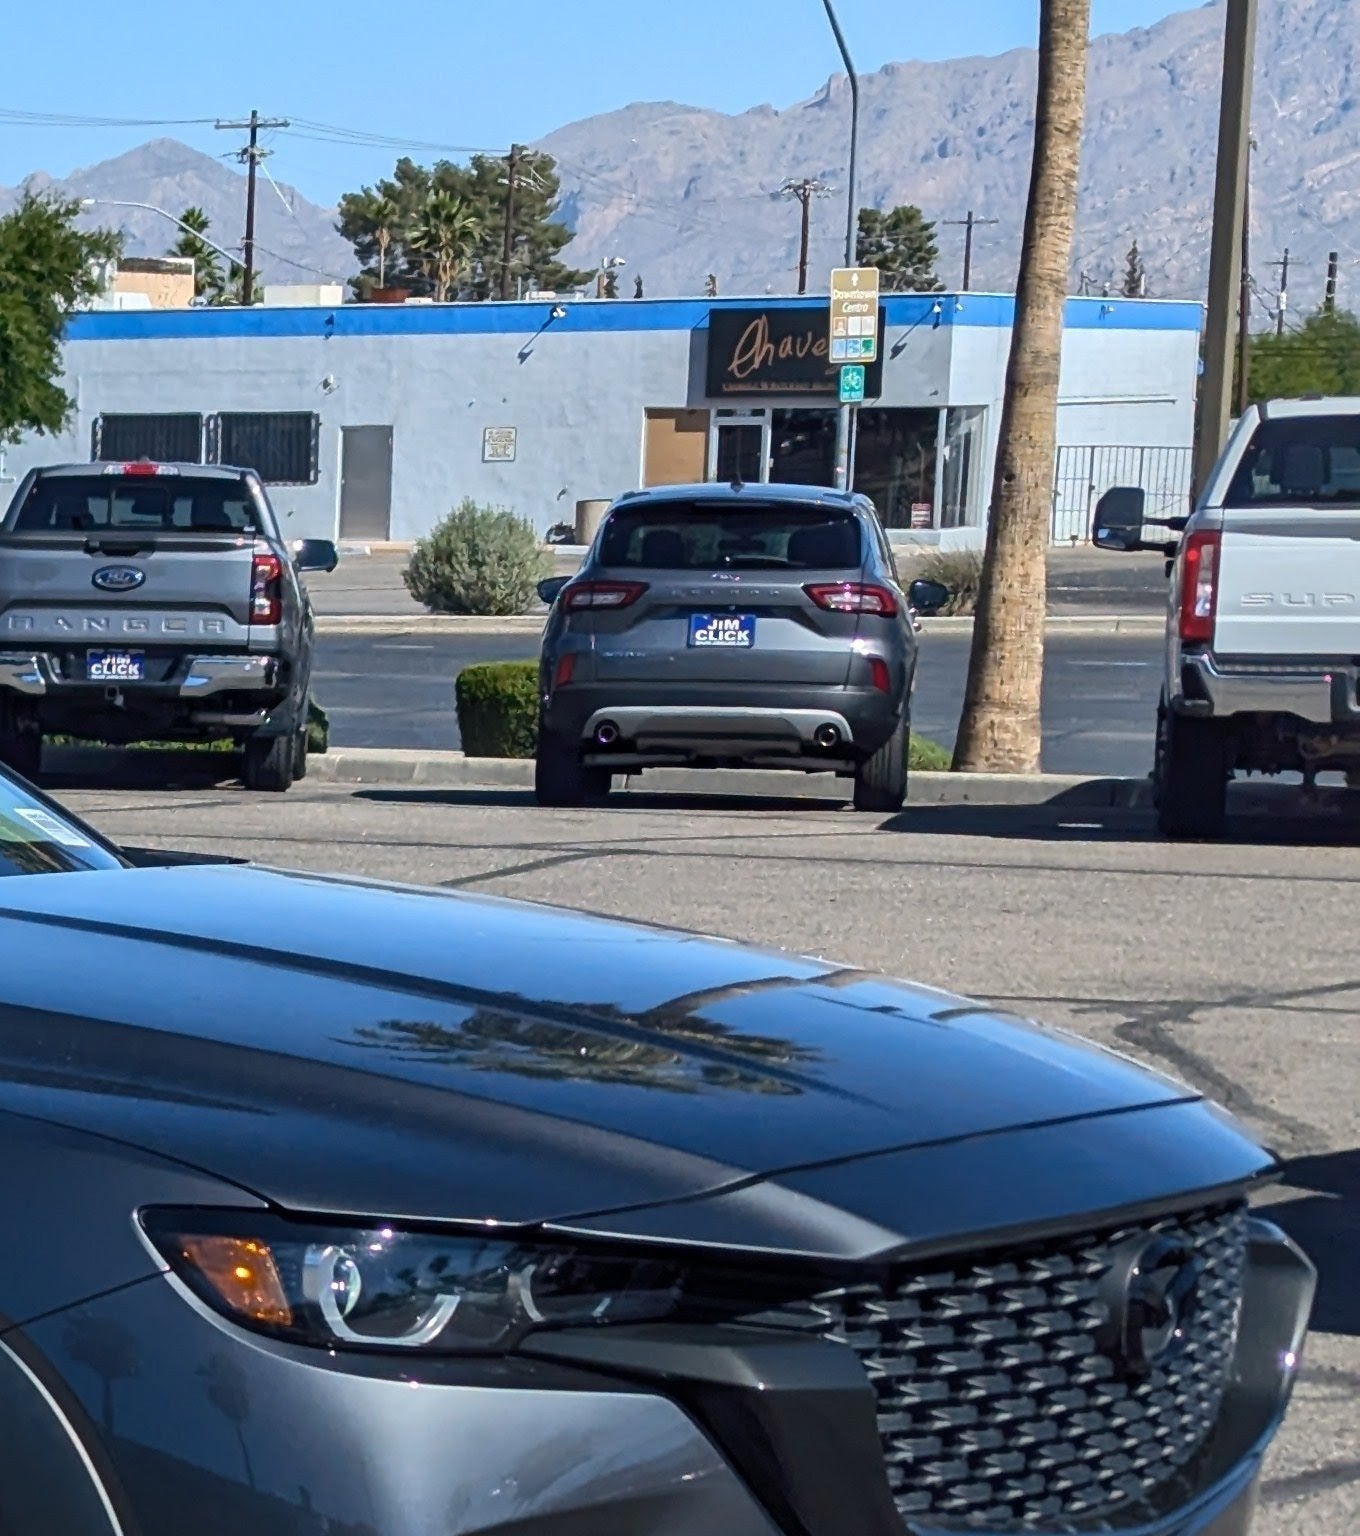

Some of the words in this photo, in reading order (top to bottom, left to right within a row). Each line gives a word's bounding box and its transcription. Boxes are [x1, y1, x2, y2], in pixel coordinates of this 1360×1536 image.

[833, 288, 877, 300] Downtown
[728, 314, 840, 378] Chave
[8, 615, 225, 634] RANGER
[707, 619, 740, 631] JIM
[695, 629, 750, 641] CLICK
[91, 663, 140, 675] CLICK
